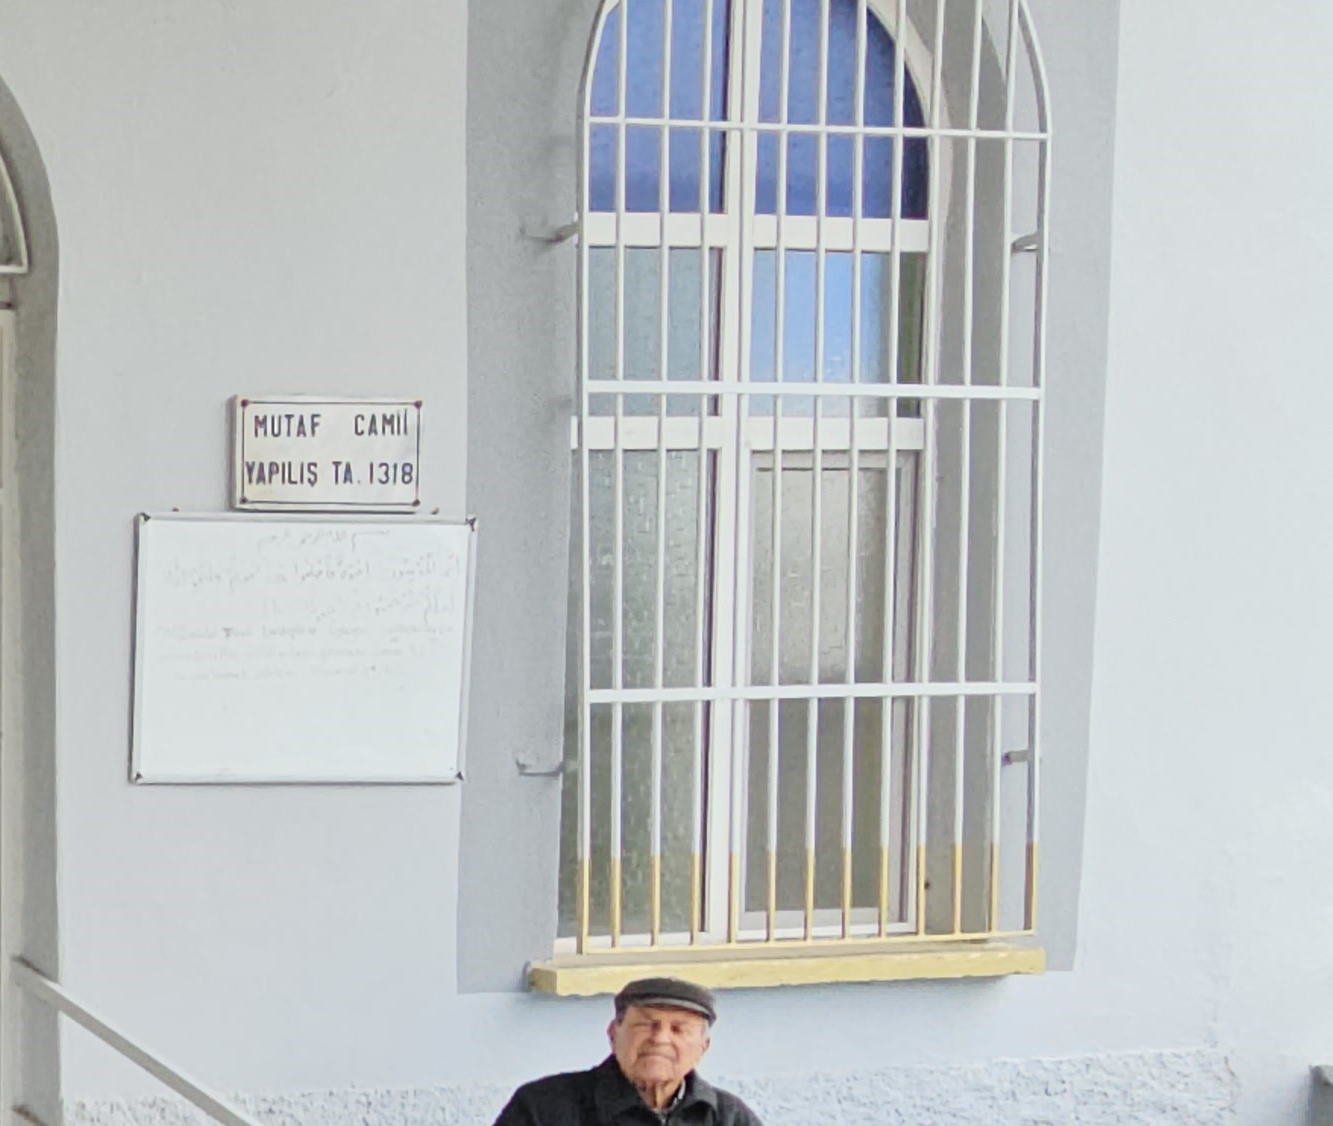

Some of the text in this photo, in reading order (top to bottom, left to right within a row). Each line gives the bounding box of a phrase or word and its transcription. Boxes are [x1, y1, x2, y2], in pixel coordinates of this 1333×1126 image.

[254, 414, 322, 438] MUTAF
[245, 461, 318, 487] YAPILIŞ
[369, 462, 414, 485] 1318
